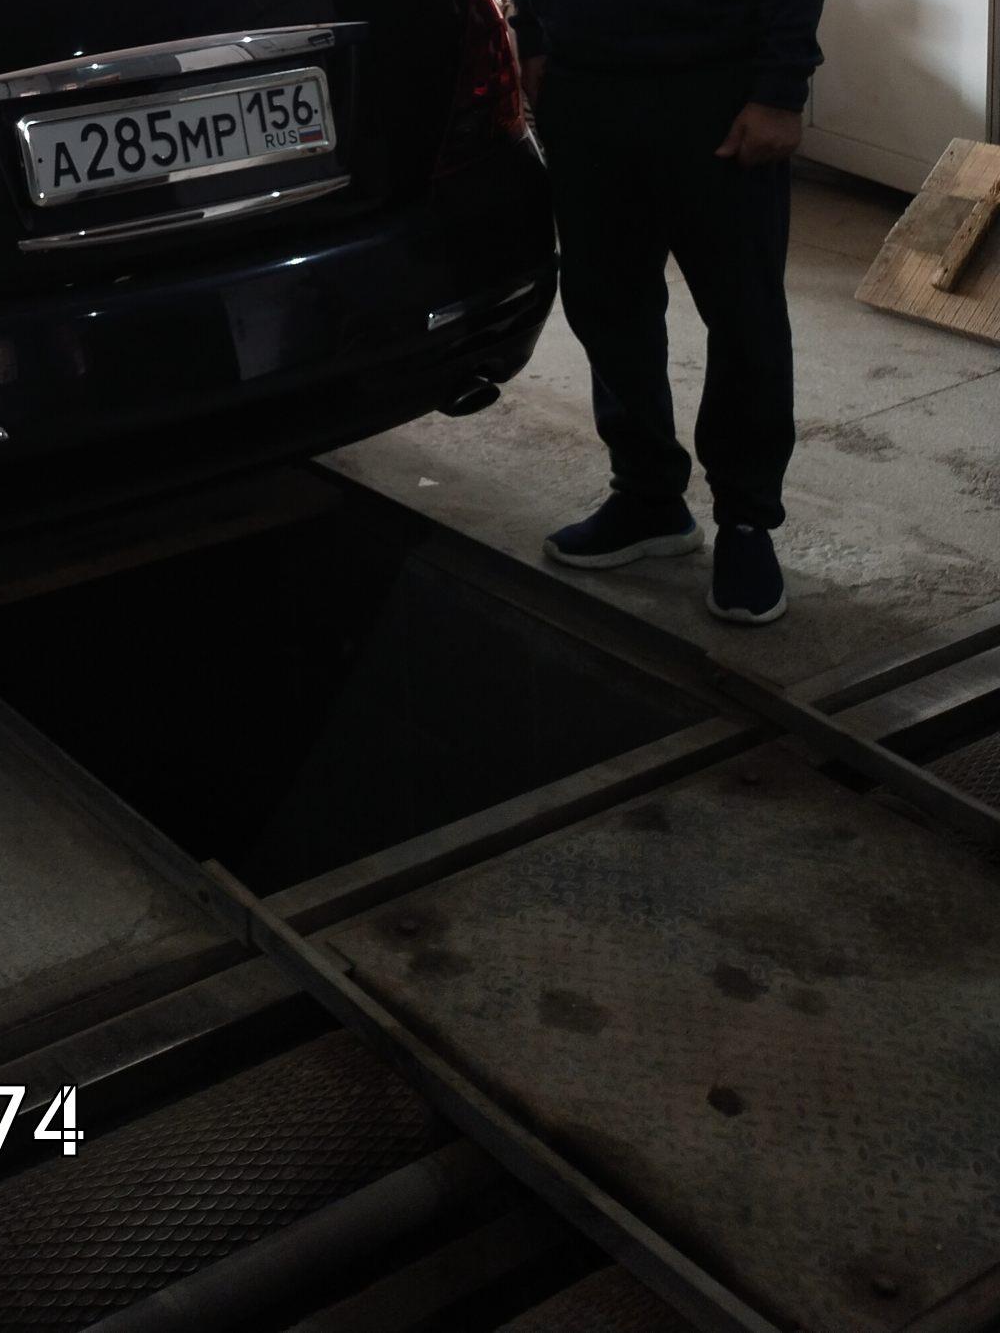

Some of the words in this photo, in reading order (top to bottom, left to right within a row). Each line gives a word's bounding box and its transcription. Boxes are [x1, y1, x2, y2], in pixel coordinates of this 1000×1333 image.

[53, 110, 237, 187] А285МР
[246, 85, 313, 133] 156
[264, 129, 298, 148] RUS
